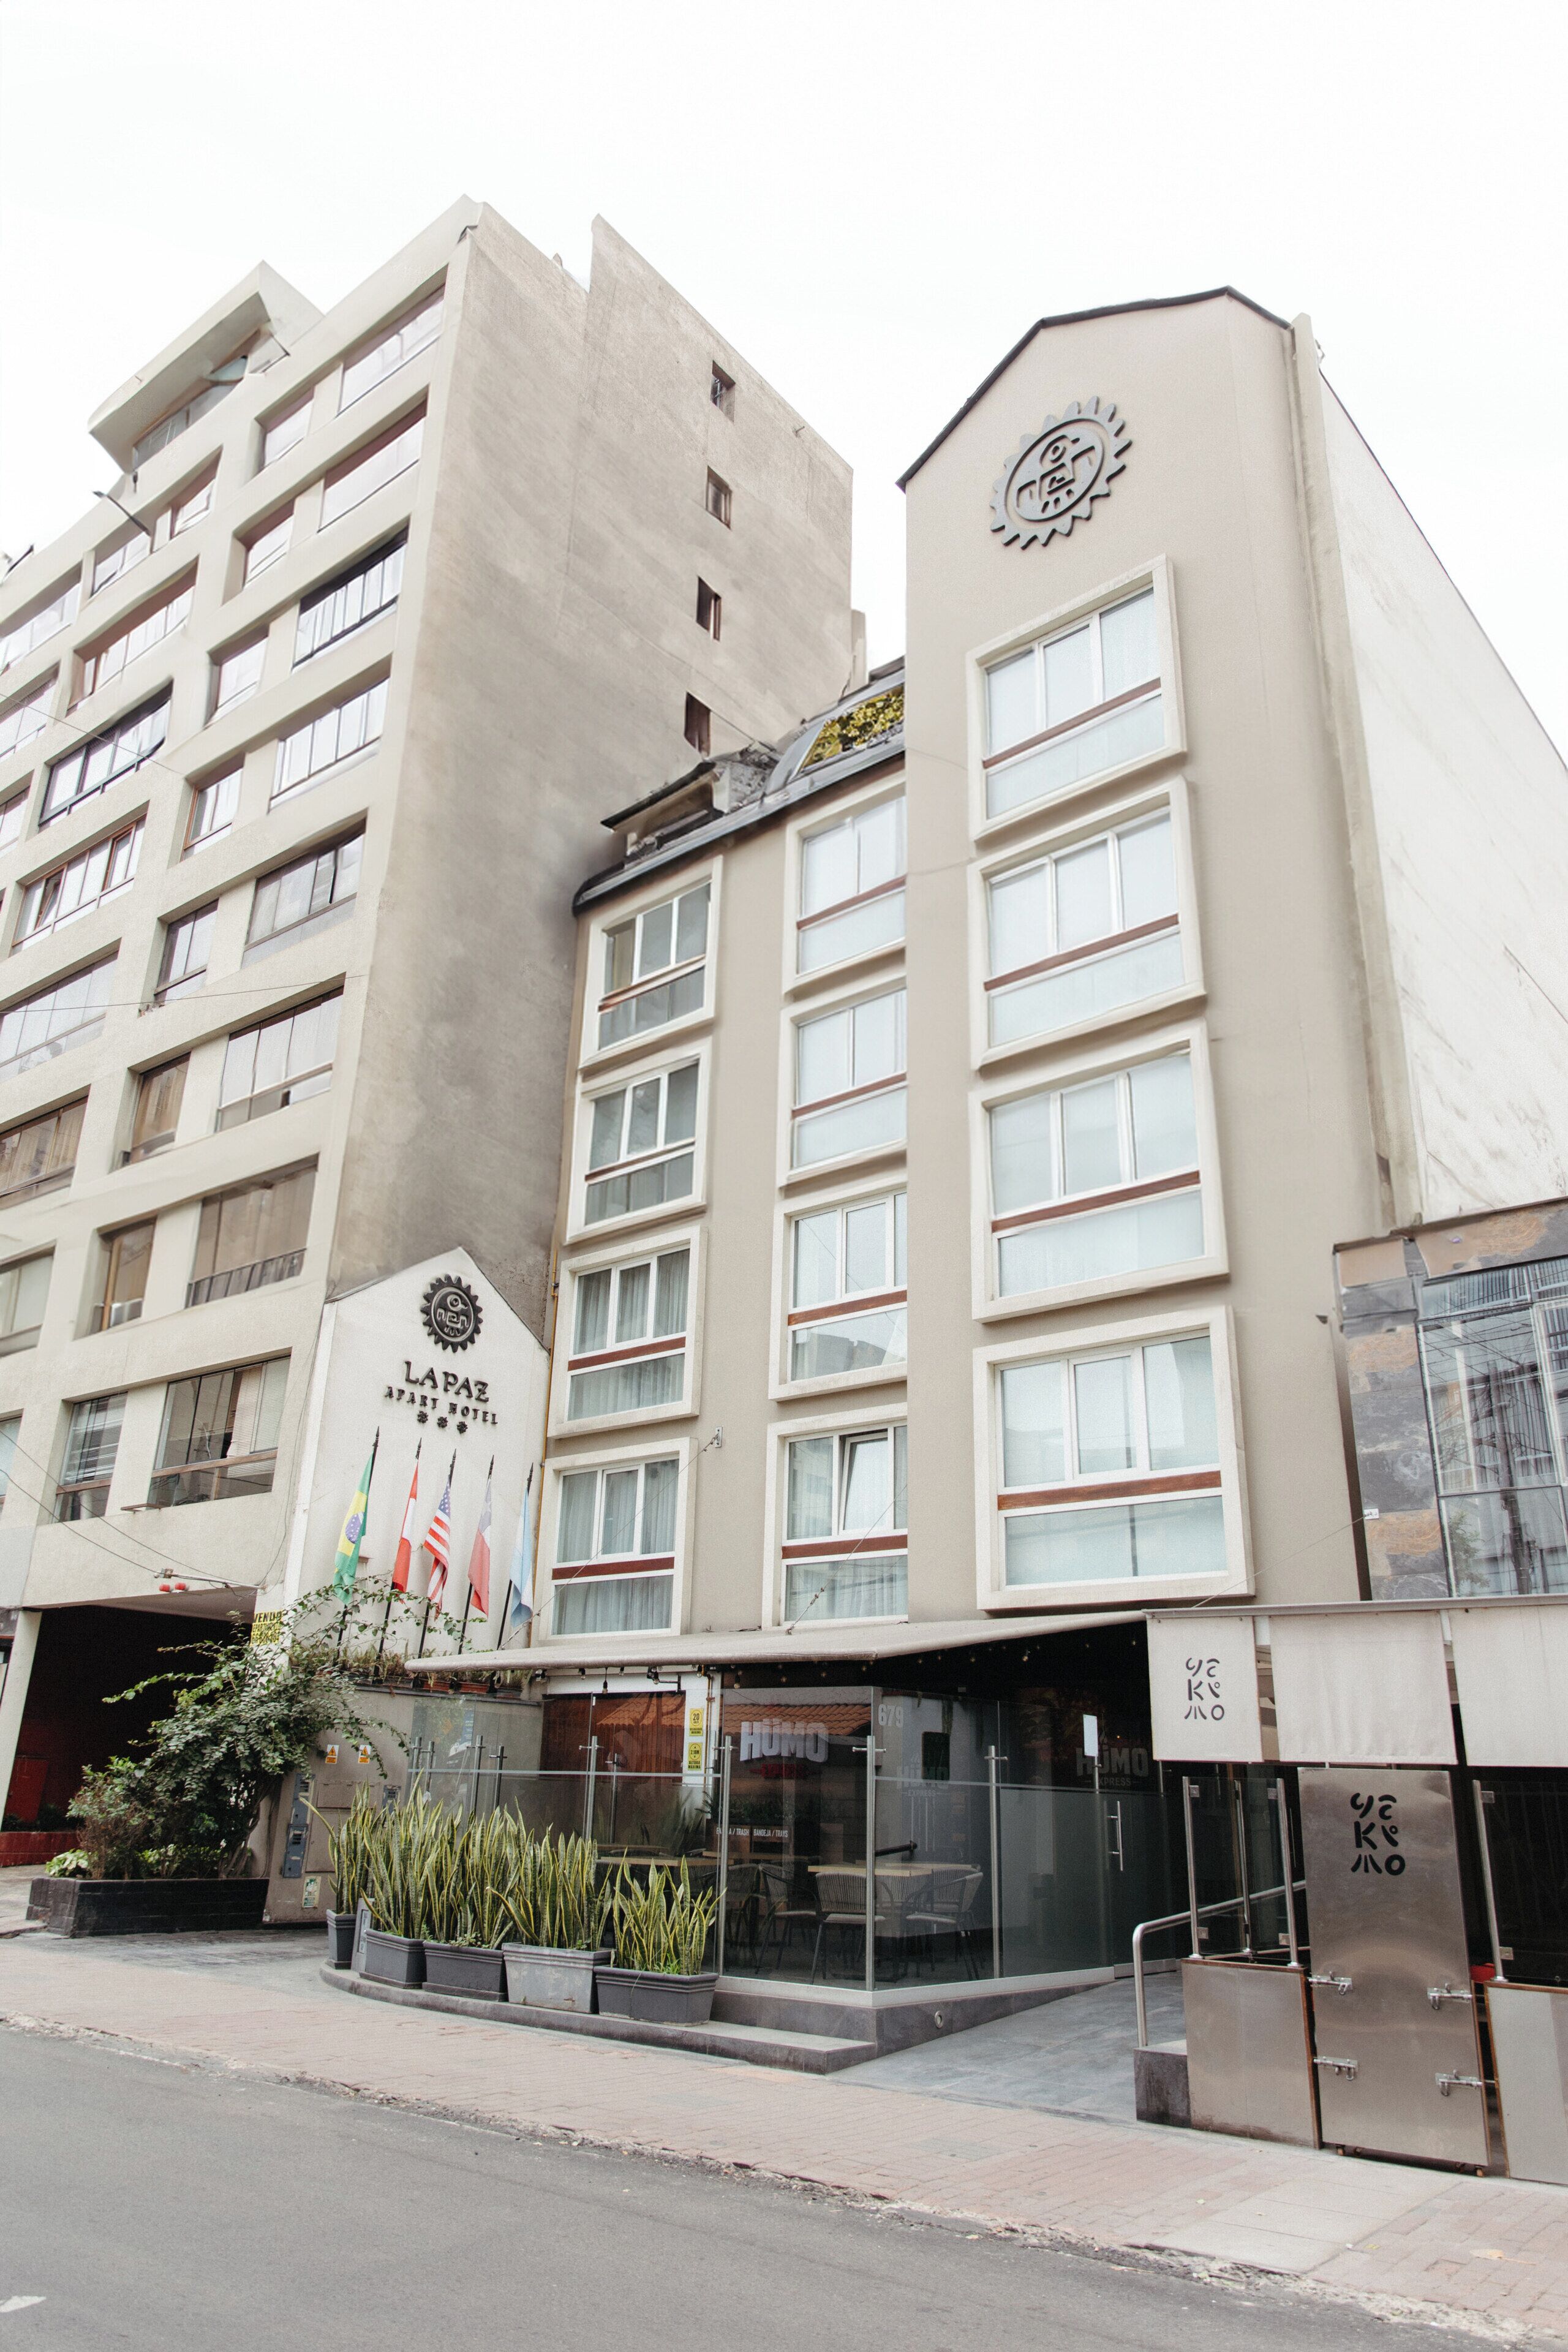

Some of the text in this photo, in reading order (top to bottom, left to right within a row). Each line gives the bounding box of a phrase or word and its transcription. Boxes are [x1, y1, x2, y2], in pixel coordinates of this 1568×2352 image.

[385, 1386, 499, 1425] APART HOTEL
[878, 1704, 903, 1727] 679
[1098, 1777, 1132, 1786] XPRESS
[753, 1828, 771, 1837] BANDEJA
